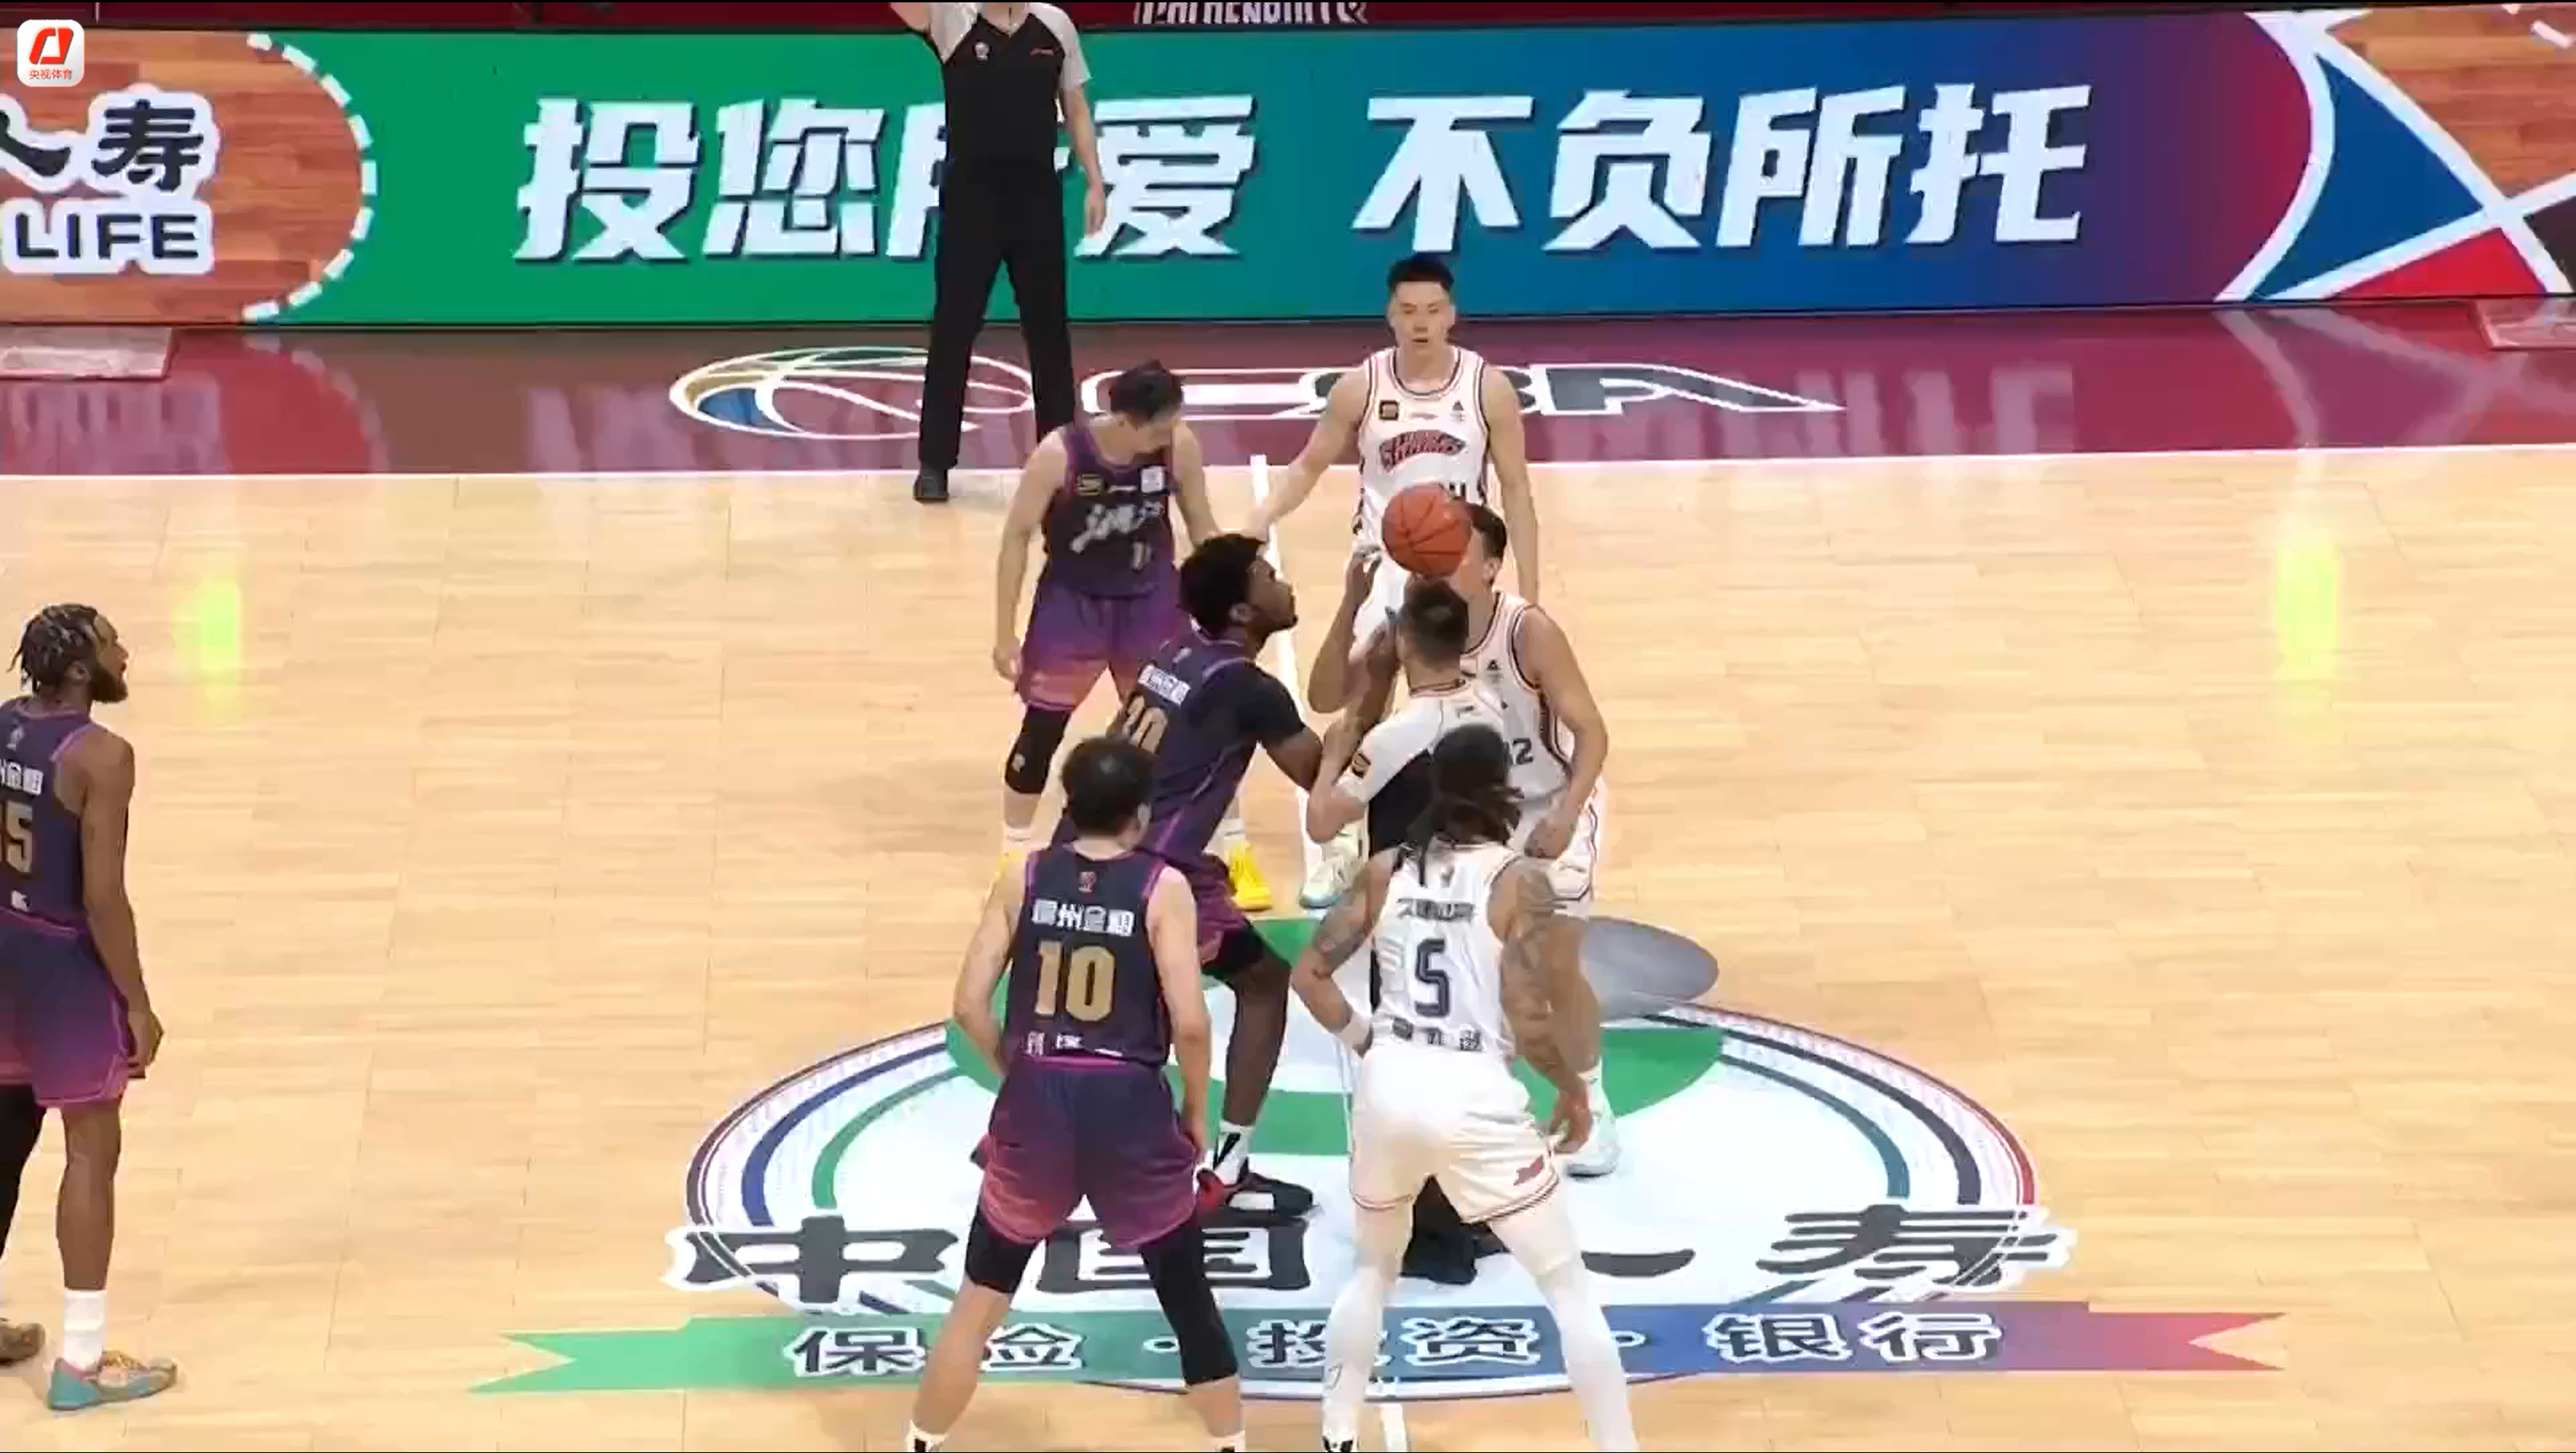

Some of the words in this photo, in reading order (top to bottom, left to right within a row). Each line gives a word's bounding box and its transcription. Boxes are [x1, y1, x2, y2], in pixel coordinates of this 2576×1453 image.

[1351, 84, 2092, 253] 不负所托
[15, 212, 199, 258] LIFE
[0, 800, 33, 874] 5
[1034, 940, 1117, 1022] 10
[1414, 938, 1451, 1019] 5
